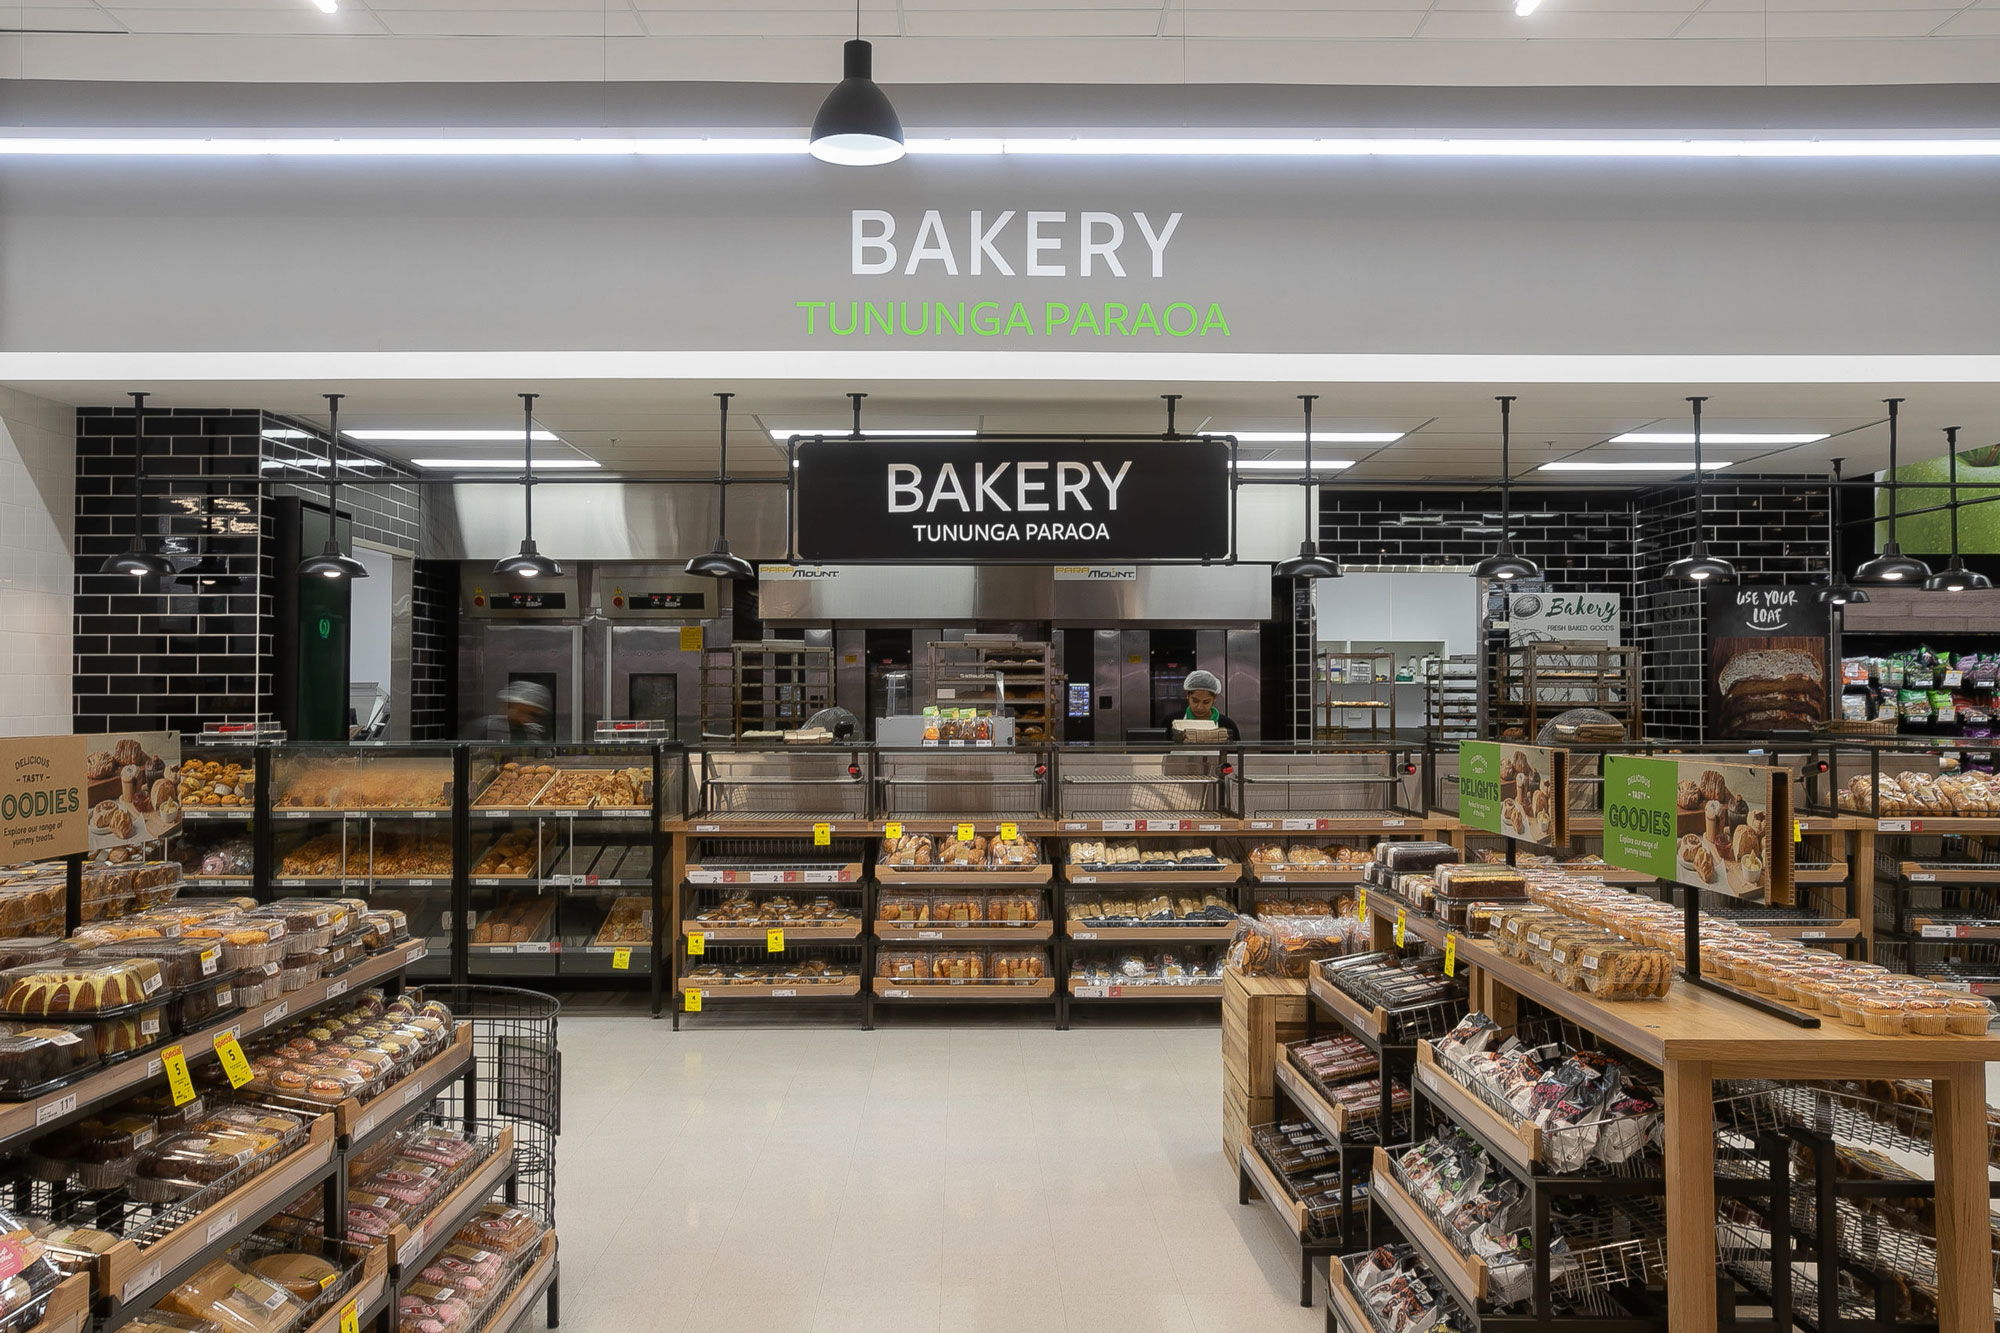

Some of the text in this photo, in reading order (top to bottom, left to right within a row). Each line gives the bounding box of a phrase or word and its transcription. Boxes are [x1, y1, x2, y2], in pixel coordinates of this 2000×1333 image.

[851, 210, 1183, 278] BAKERY
[796, 301, 1230, 336] TUNUNGA PARAOA
[887, 461, 1132, 513] BAKERY
[912, 522, 1110, 542] TUNUNGA PARAOA
[1737, 590, 1798, 607] USE YOUR
[1545, 595, 1620, 623] Bakery
[1753, 608, 1782, 623] LOAF
[15, 756, 50, 770] DELICIOUS
[1461, 777, 1499, 802] DELIGHTS
[1627, 774, 1651, 788] DELICIOUS
[3, 820, 64, 837] Explore our range of
[1609, 803, 1671, 837] GOODIES
[12, 837, 34, 848] yummy
